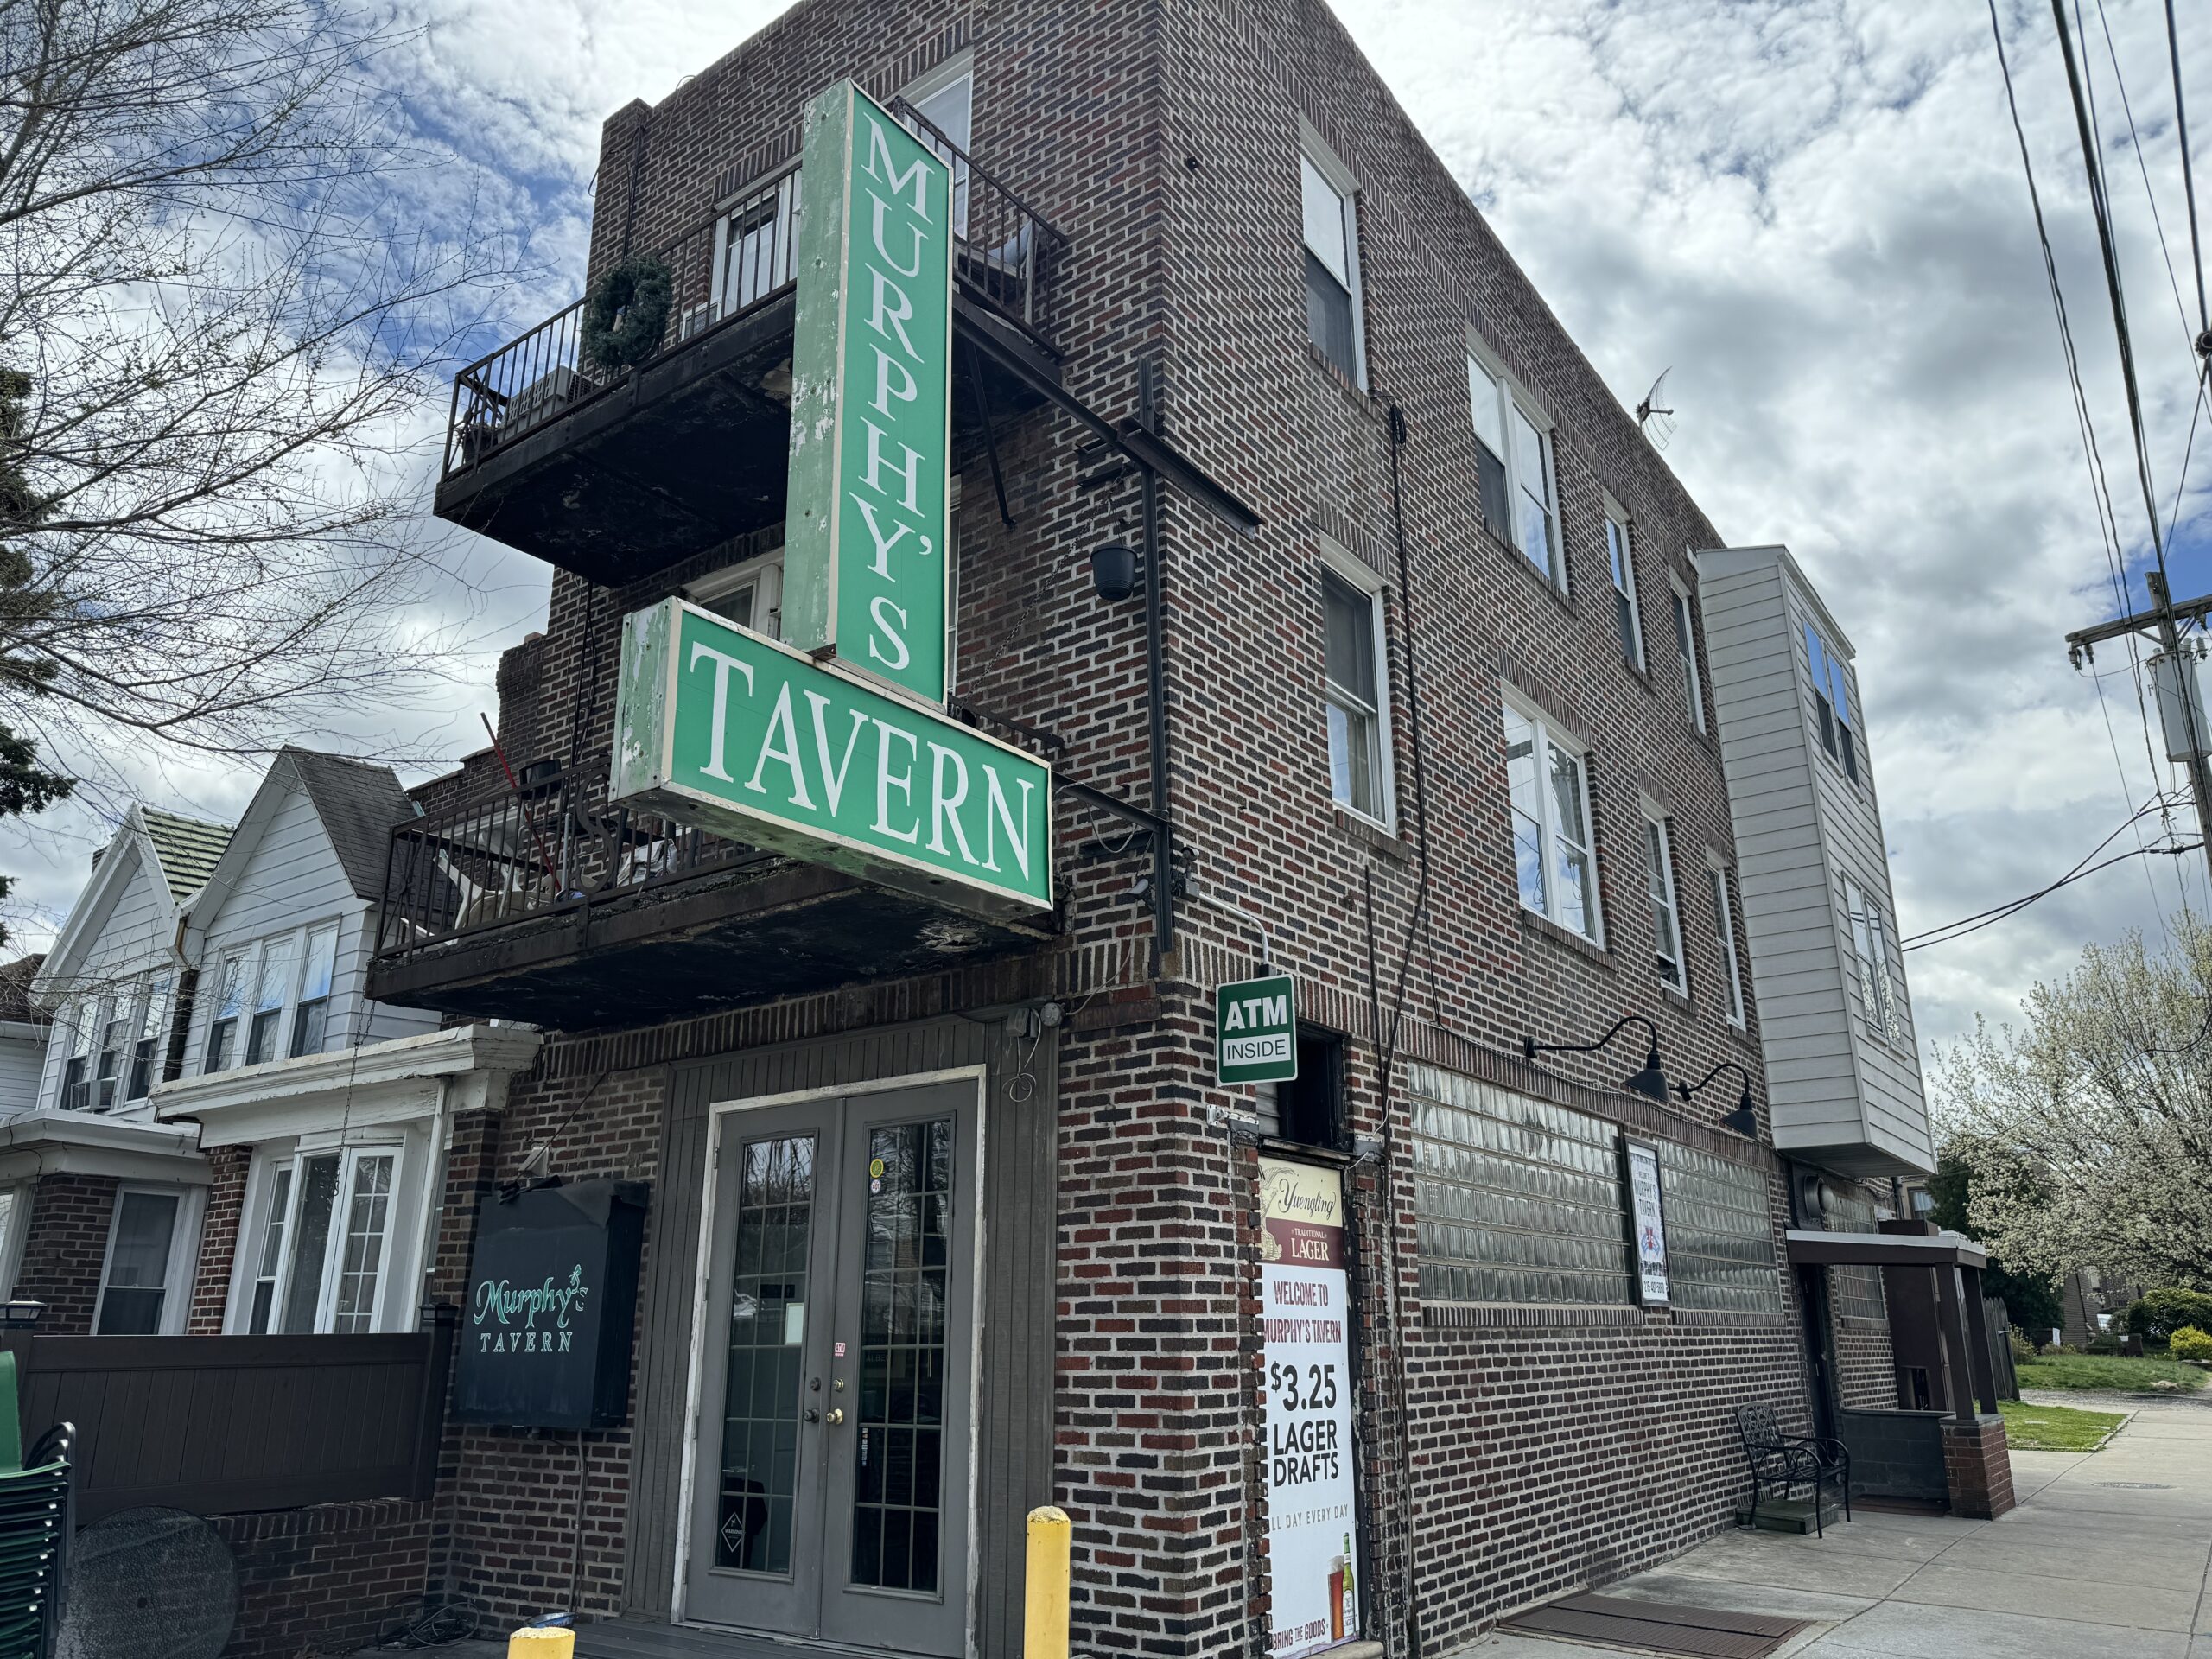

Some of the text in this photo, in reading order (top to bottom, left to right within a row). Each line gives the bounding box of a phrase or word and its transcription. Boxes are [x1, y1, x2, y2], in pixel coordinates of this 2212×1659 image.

[849, 111, 934, 670] MURPHY'S
[690, 641, 1034, 881] TAVERN
[1224, 995, 1287, 1031] ATM
[1227, 1039, 1286, 1060] INSIDE
[1278, 1178, 1337, 1221] Yuengling
[1291, 1237, 1329, 1261] LAGER
[1294, 1228, 1325, 1238] TRADITIONAL
[1274, 1281, 1329, 1306] WELCOME TO
[480, 1332, 573, 1353] TAVERN
[1312, 1320, 1342, 1343] TAVERN
[1270, 1360, 1337, 1411] $3.25
[1274, 1419, 1338, 1455] LAGER
[1274, 1452, 1338, 1487] DRAFTS
[1272, 1503, 1348, 1531] LL DAY EVERY DAY
[1273, 1628, 1294, 1651] BRING
[1305, 1618, 1325, 1641] GOODS
